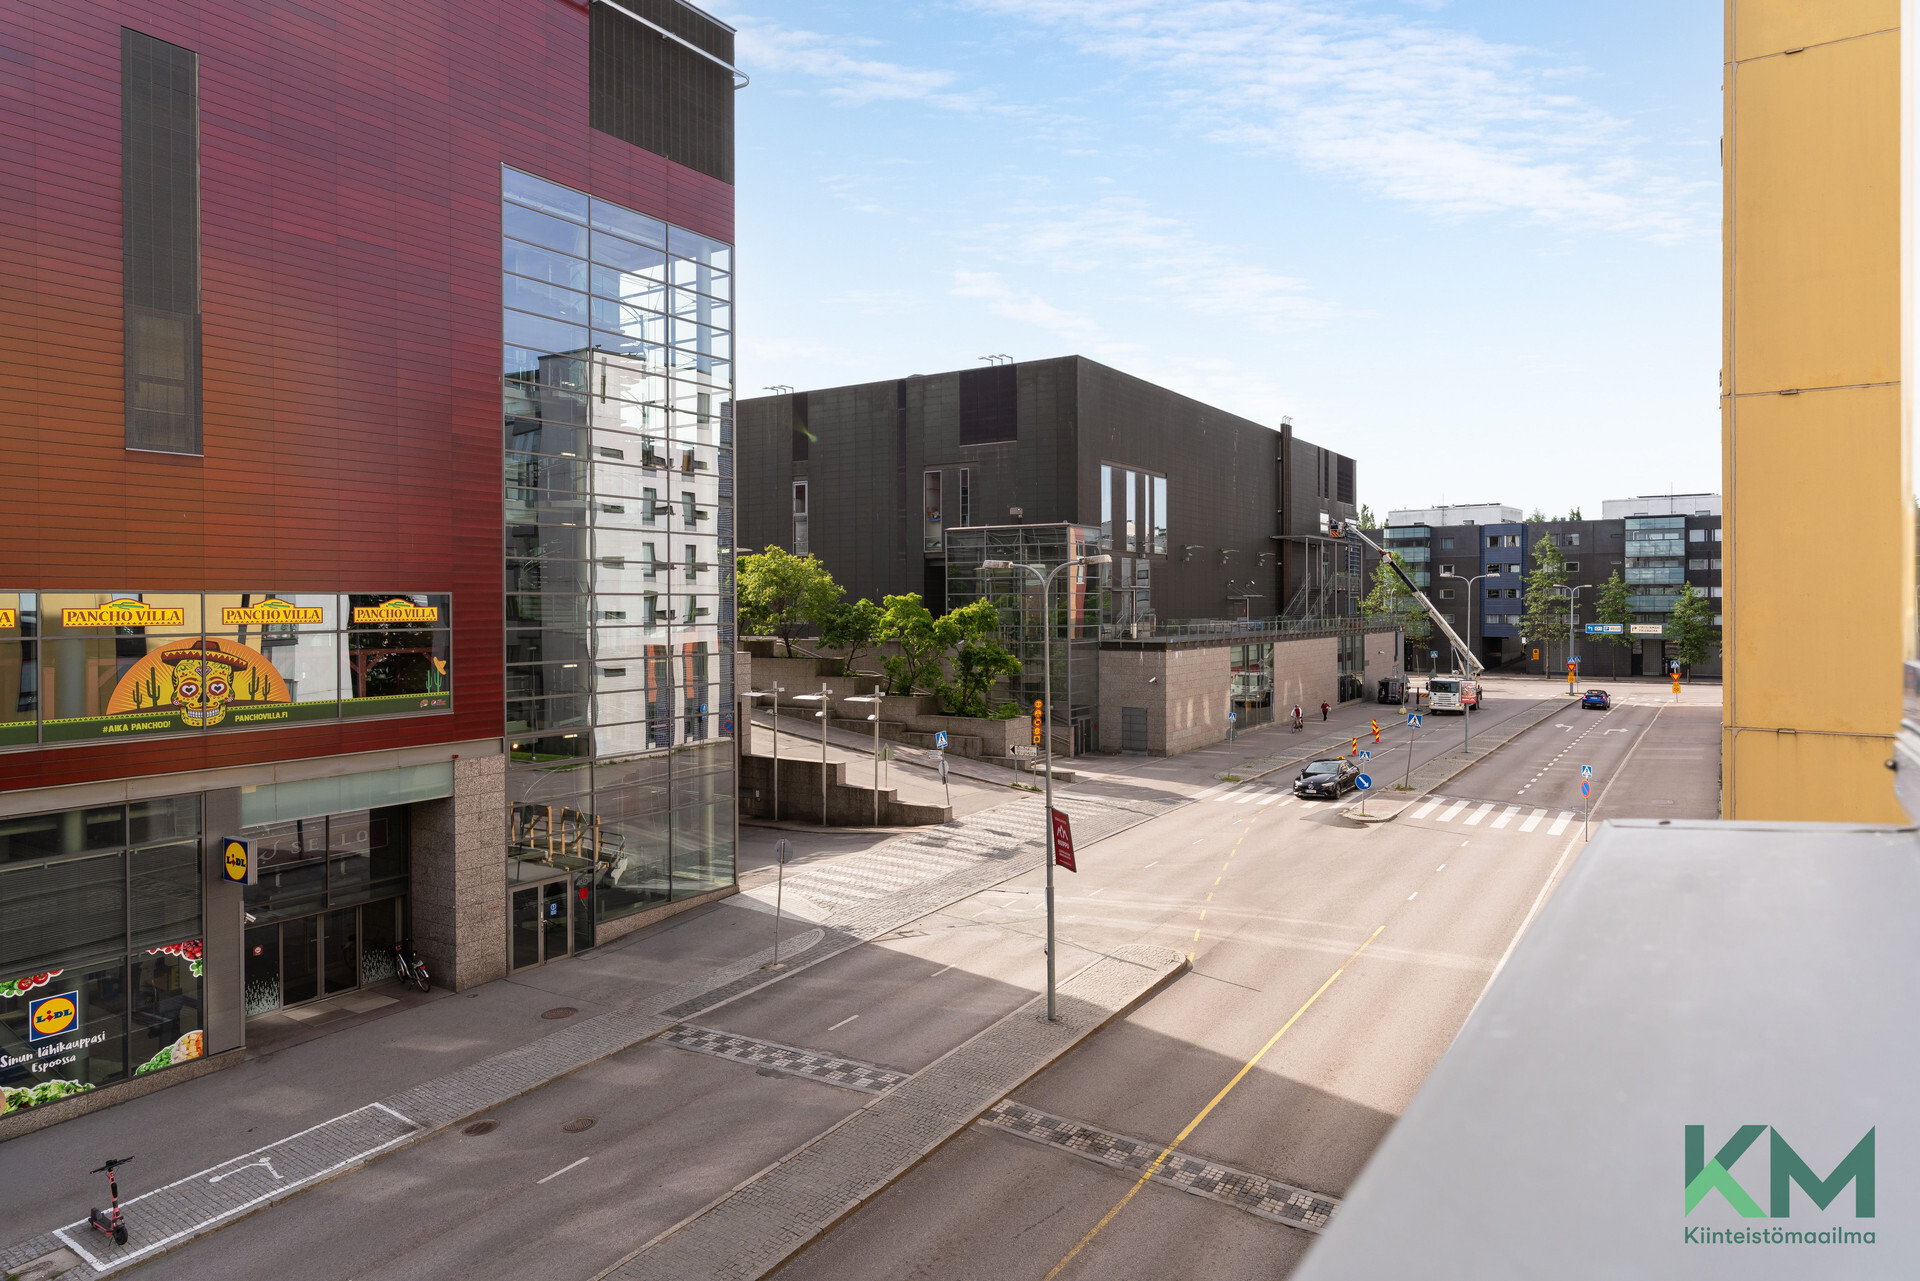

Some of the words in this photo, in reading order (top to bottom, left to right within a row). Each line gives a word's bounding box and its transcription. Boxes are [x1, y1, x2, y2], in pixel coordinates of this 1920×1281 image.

[67, 610, 133, 622] PANCHO
[135, 610, 181, 622] VILLA
[226, 609, 281, 620] PANCHO
[283, 608, 320, 620] VILLA
[356, 608, 404, 619] PANCHO
[404, 608, 436, 619] VILLA
[234, 711, 288, 723] PANCHOVILLA.FI
[102, 723, 129, 734] #AIKA
[131, 721, 171, 732] PANCHOO!
[0, 1053, 33, 1068] Sinun
[37, 1030, 107, 1058] lähikauppasi
[31, 1054, 77, 1073] Espoossa
